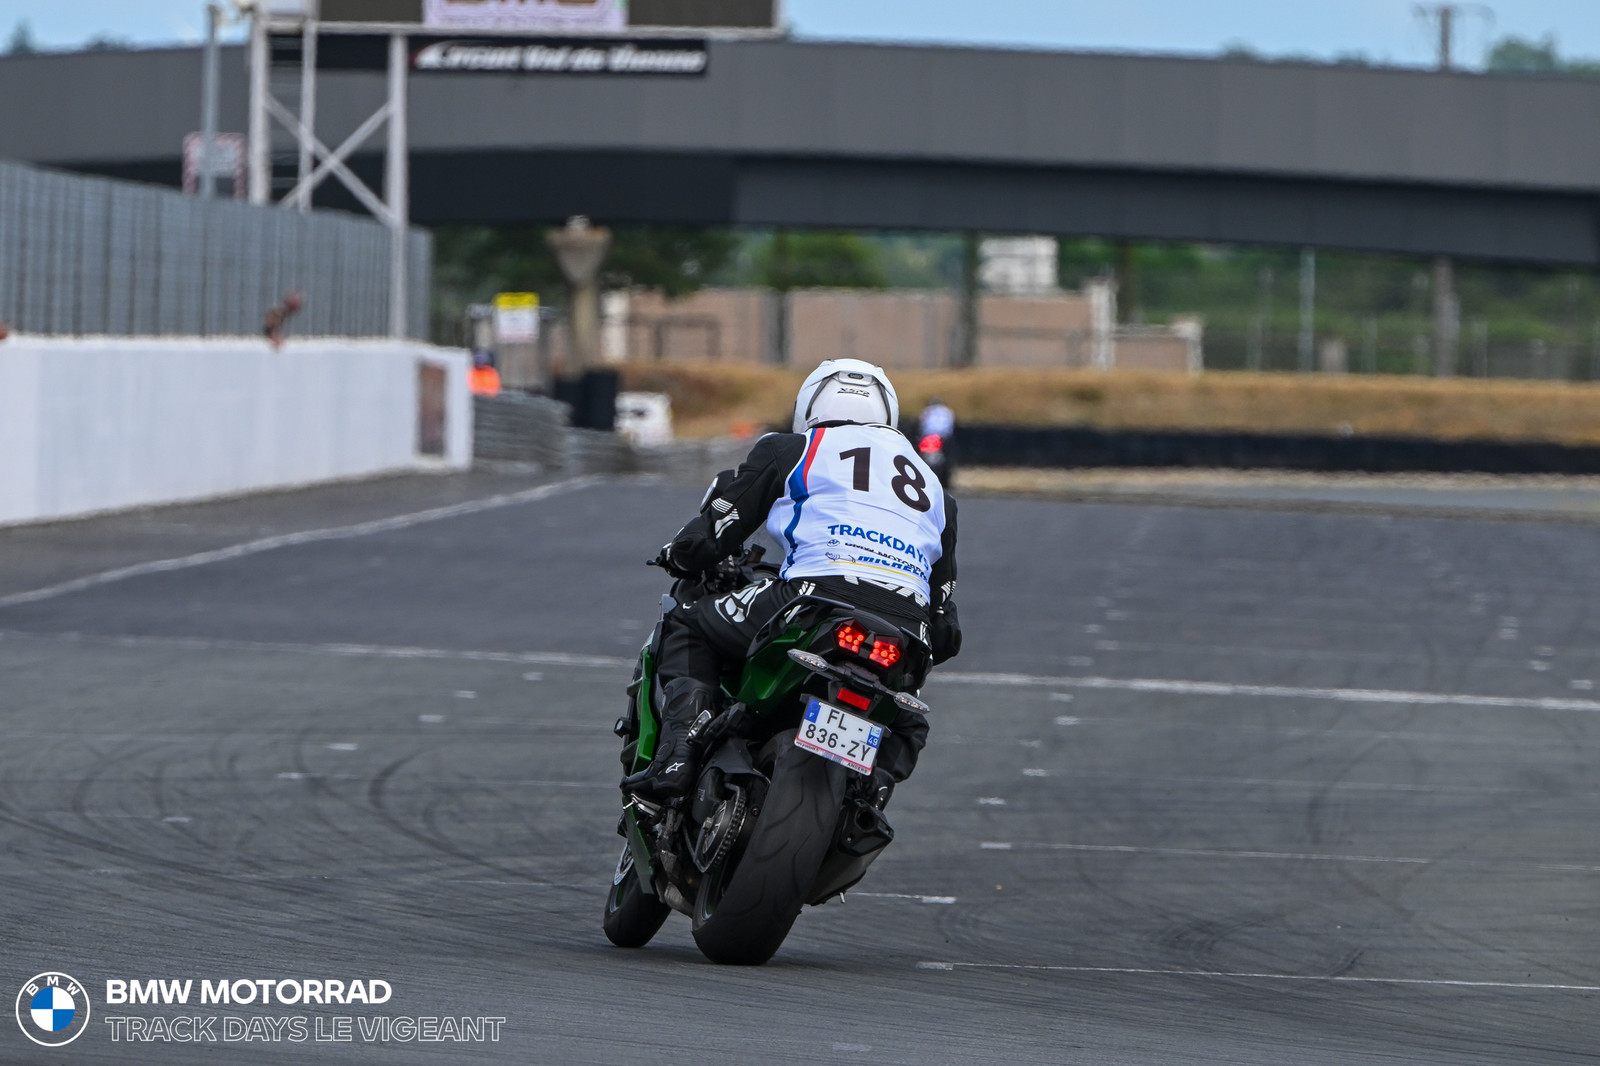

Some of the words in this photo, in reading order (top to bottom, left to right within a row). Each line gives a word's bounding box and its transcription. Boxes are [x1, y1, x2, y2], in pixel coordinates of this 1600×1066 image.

[839, 446, 931, 513] 18
[827, 708, 847, 731] FL
[805, 724, 871, 762] 836-ZY
[868, 737, 878, 746] 49
